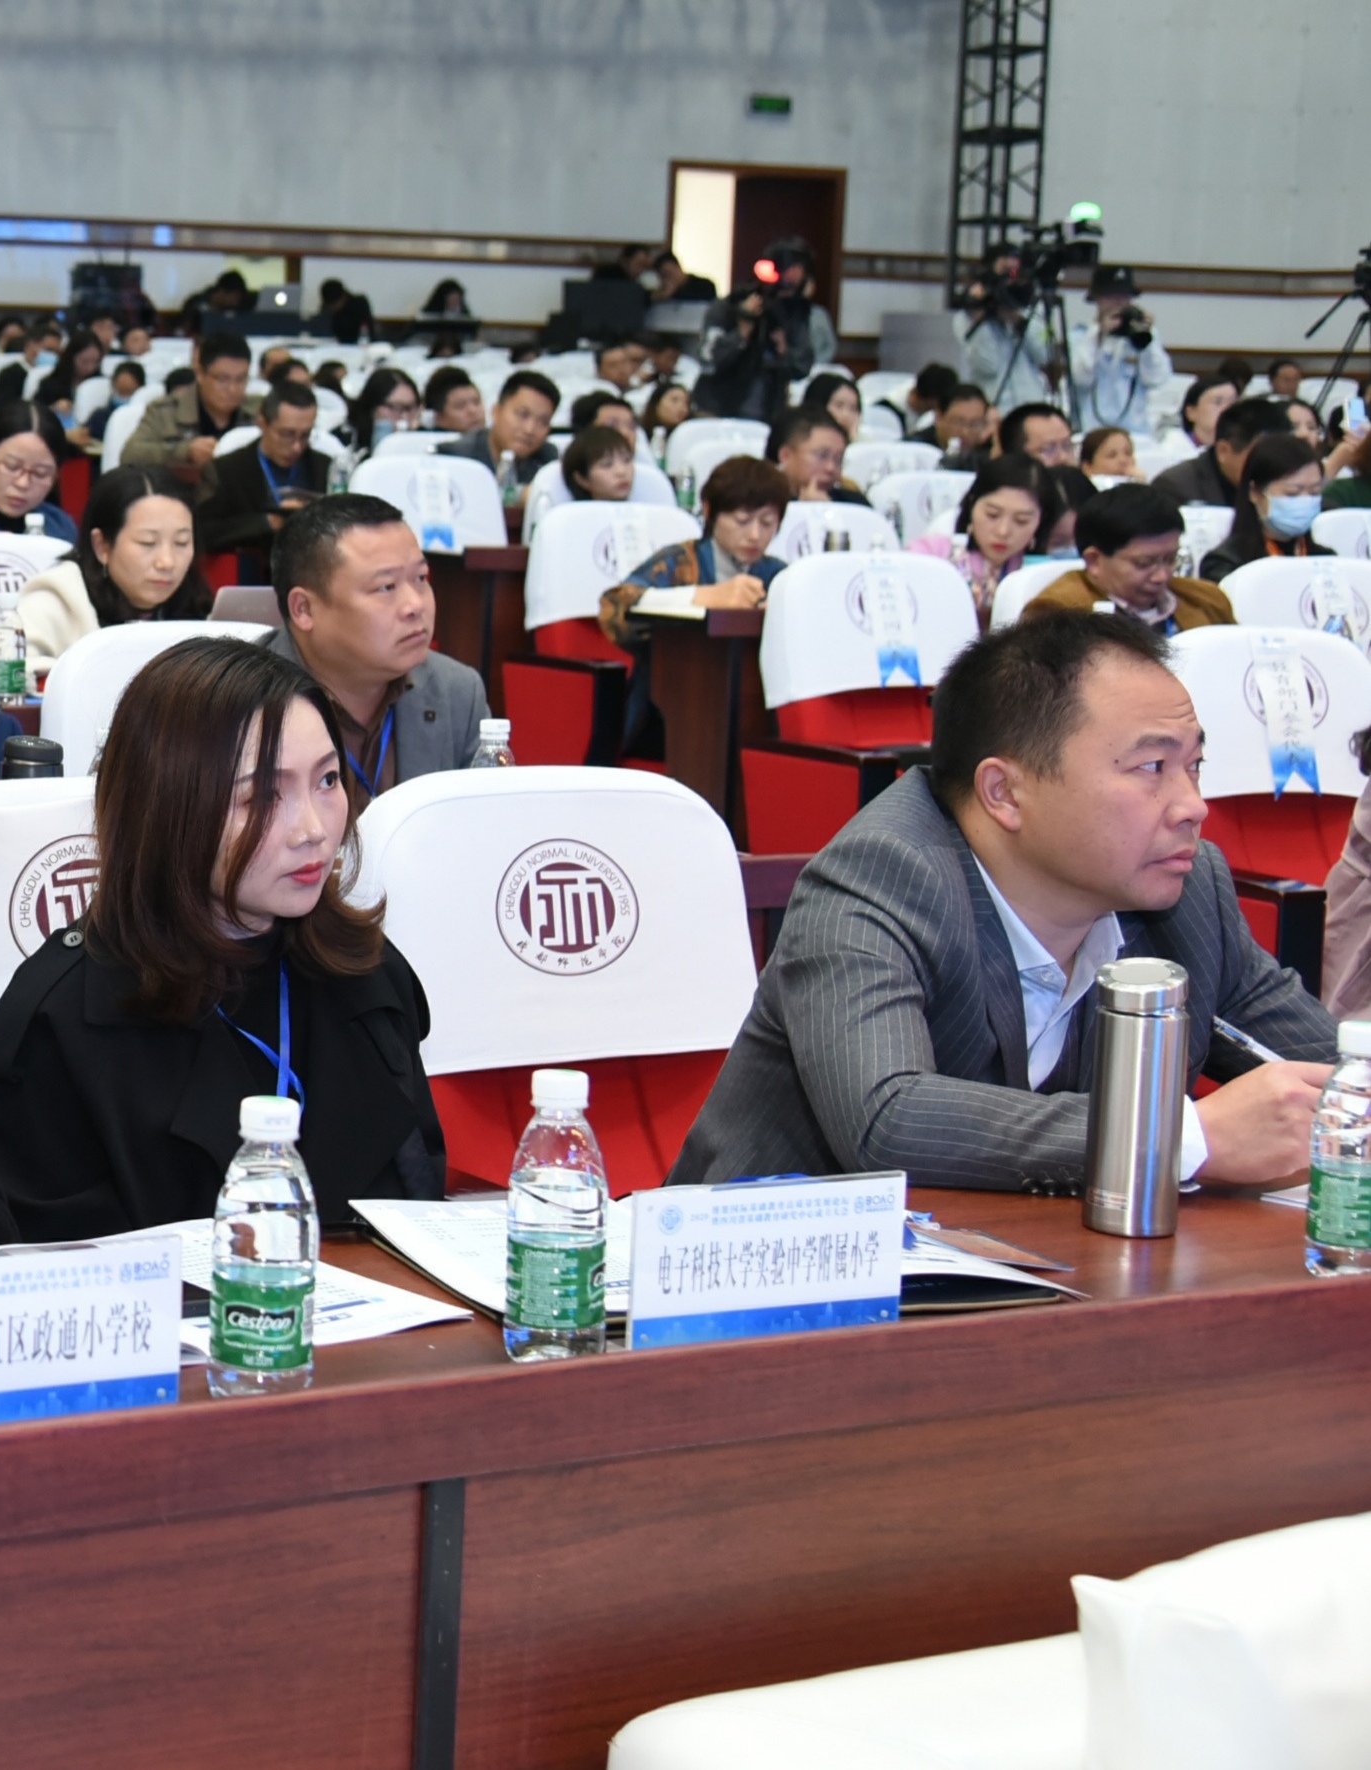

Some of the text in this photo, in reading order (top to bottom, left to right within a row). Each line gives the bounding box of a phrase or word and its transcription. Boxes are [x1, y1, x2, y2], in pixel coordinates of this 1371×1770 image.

[19, 844, 88, 928] CHENGDU NORMAL
[505, 847, 631, 920] CHENGDU NORMAL UNIVERSITY 1955
[865, 1194, 895, 1206] BOAO
[133, 1259, 171, 1275] BOAO
[658, 1230, 880, 1295] 电子科技大学实验中学附属小学
